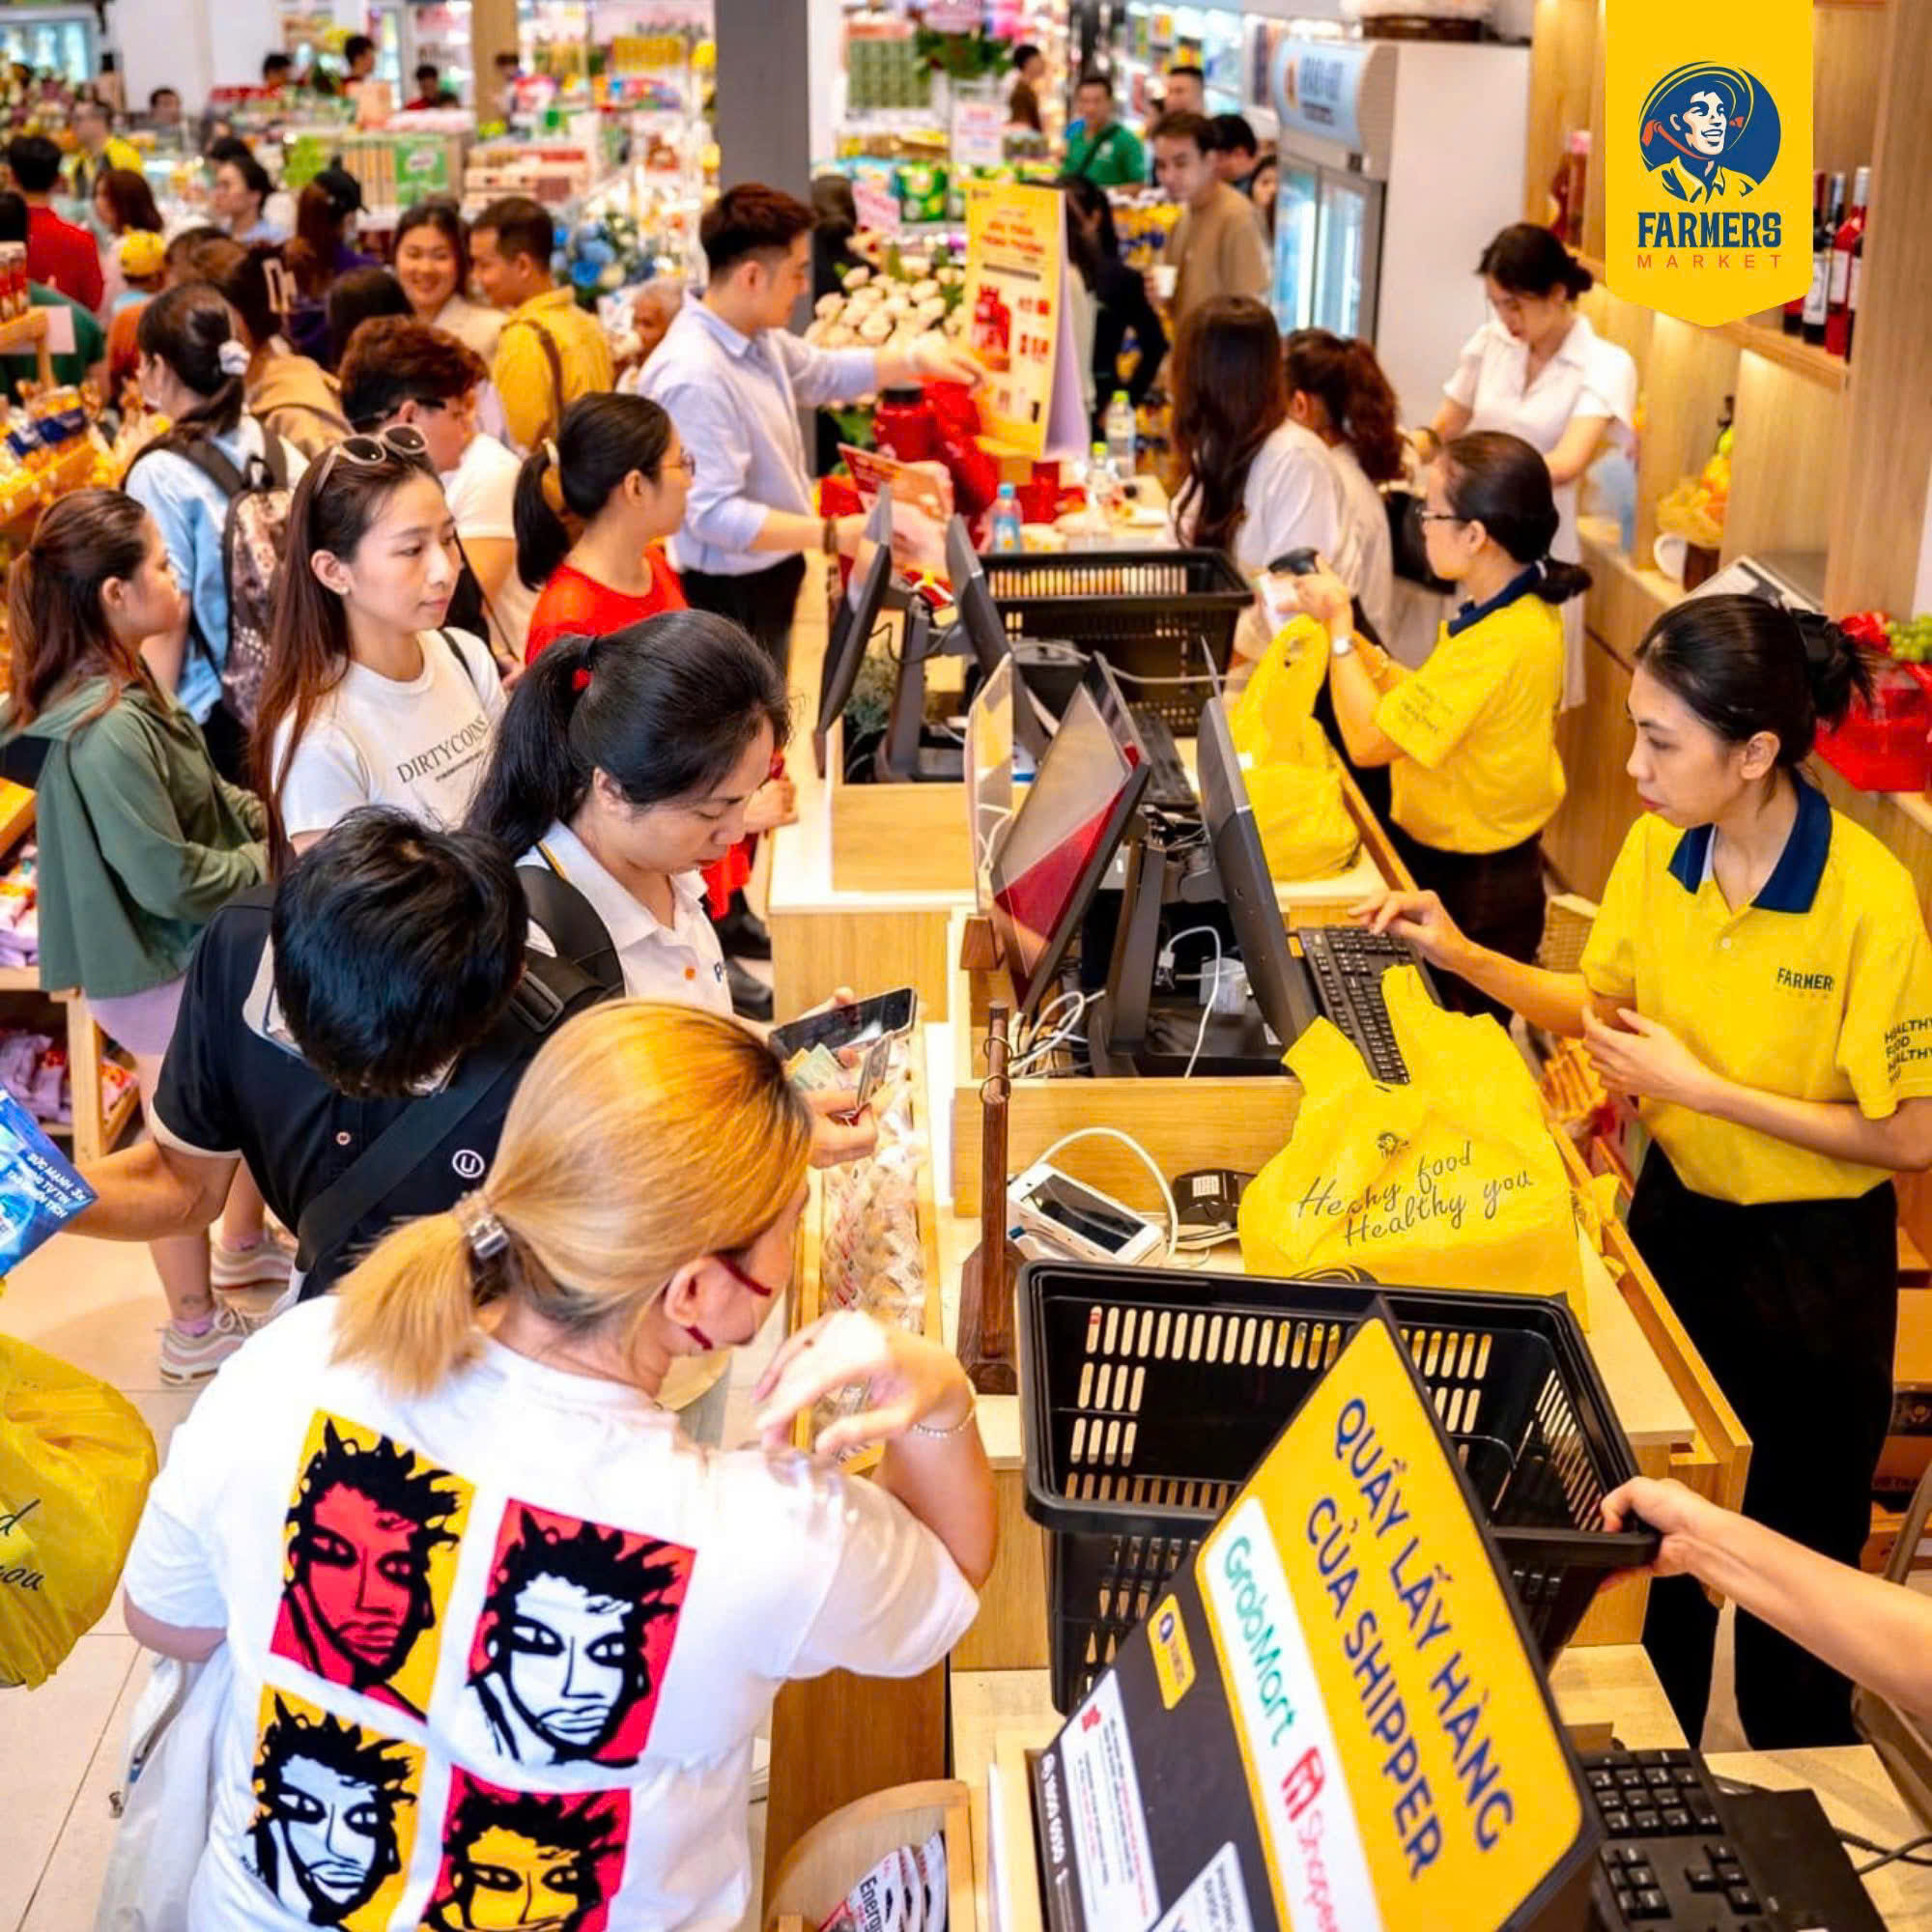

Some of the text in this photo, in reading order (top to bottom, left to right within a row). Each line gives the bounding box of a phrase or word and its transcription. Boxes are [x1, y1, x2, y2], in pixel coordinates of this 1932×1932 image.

[1777, 967, 1834, 991] FARMER
[1418, 1141, 1471, 1194] food
[1345, 1171, 1534, 1246] Healthy you
[1308, 1497, 1442, 1880] CỦA SHIPPER
[1390, 1537, 1453, 1651] LẤY
[1430, 1652, 1514, 1852] HÀNG
[860, 1875, 883, 1932] Energ
